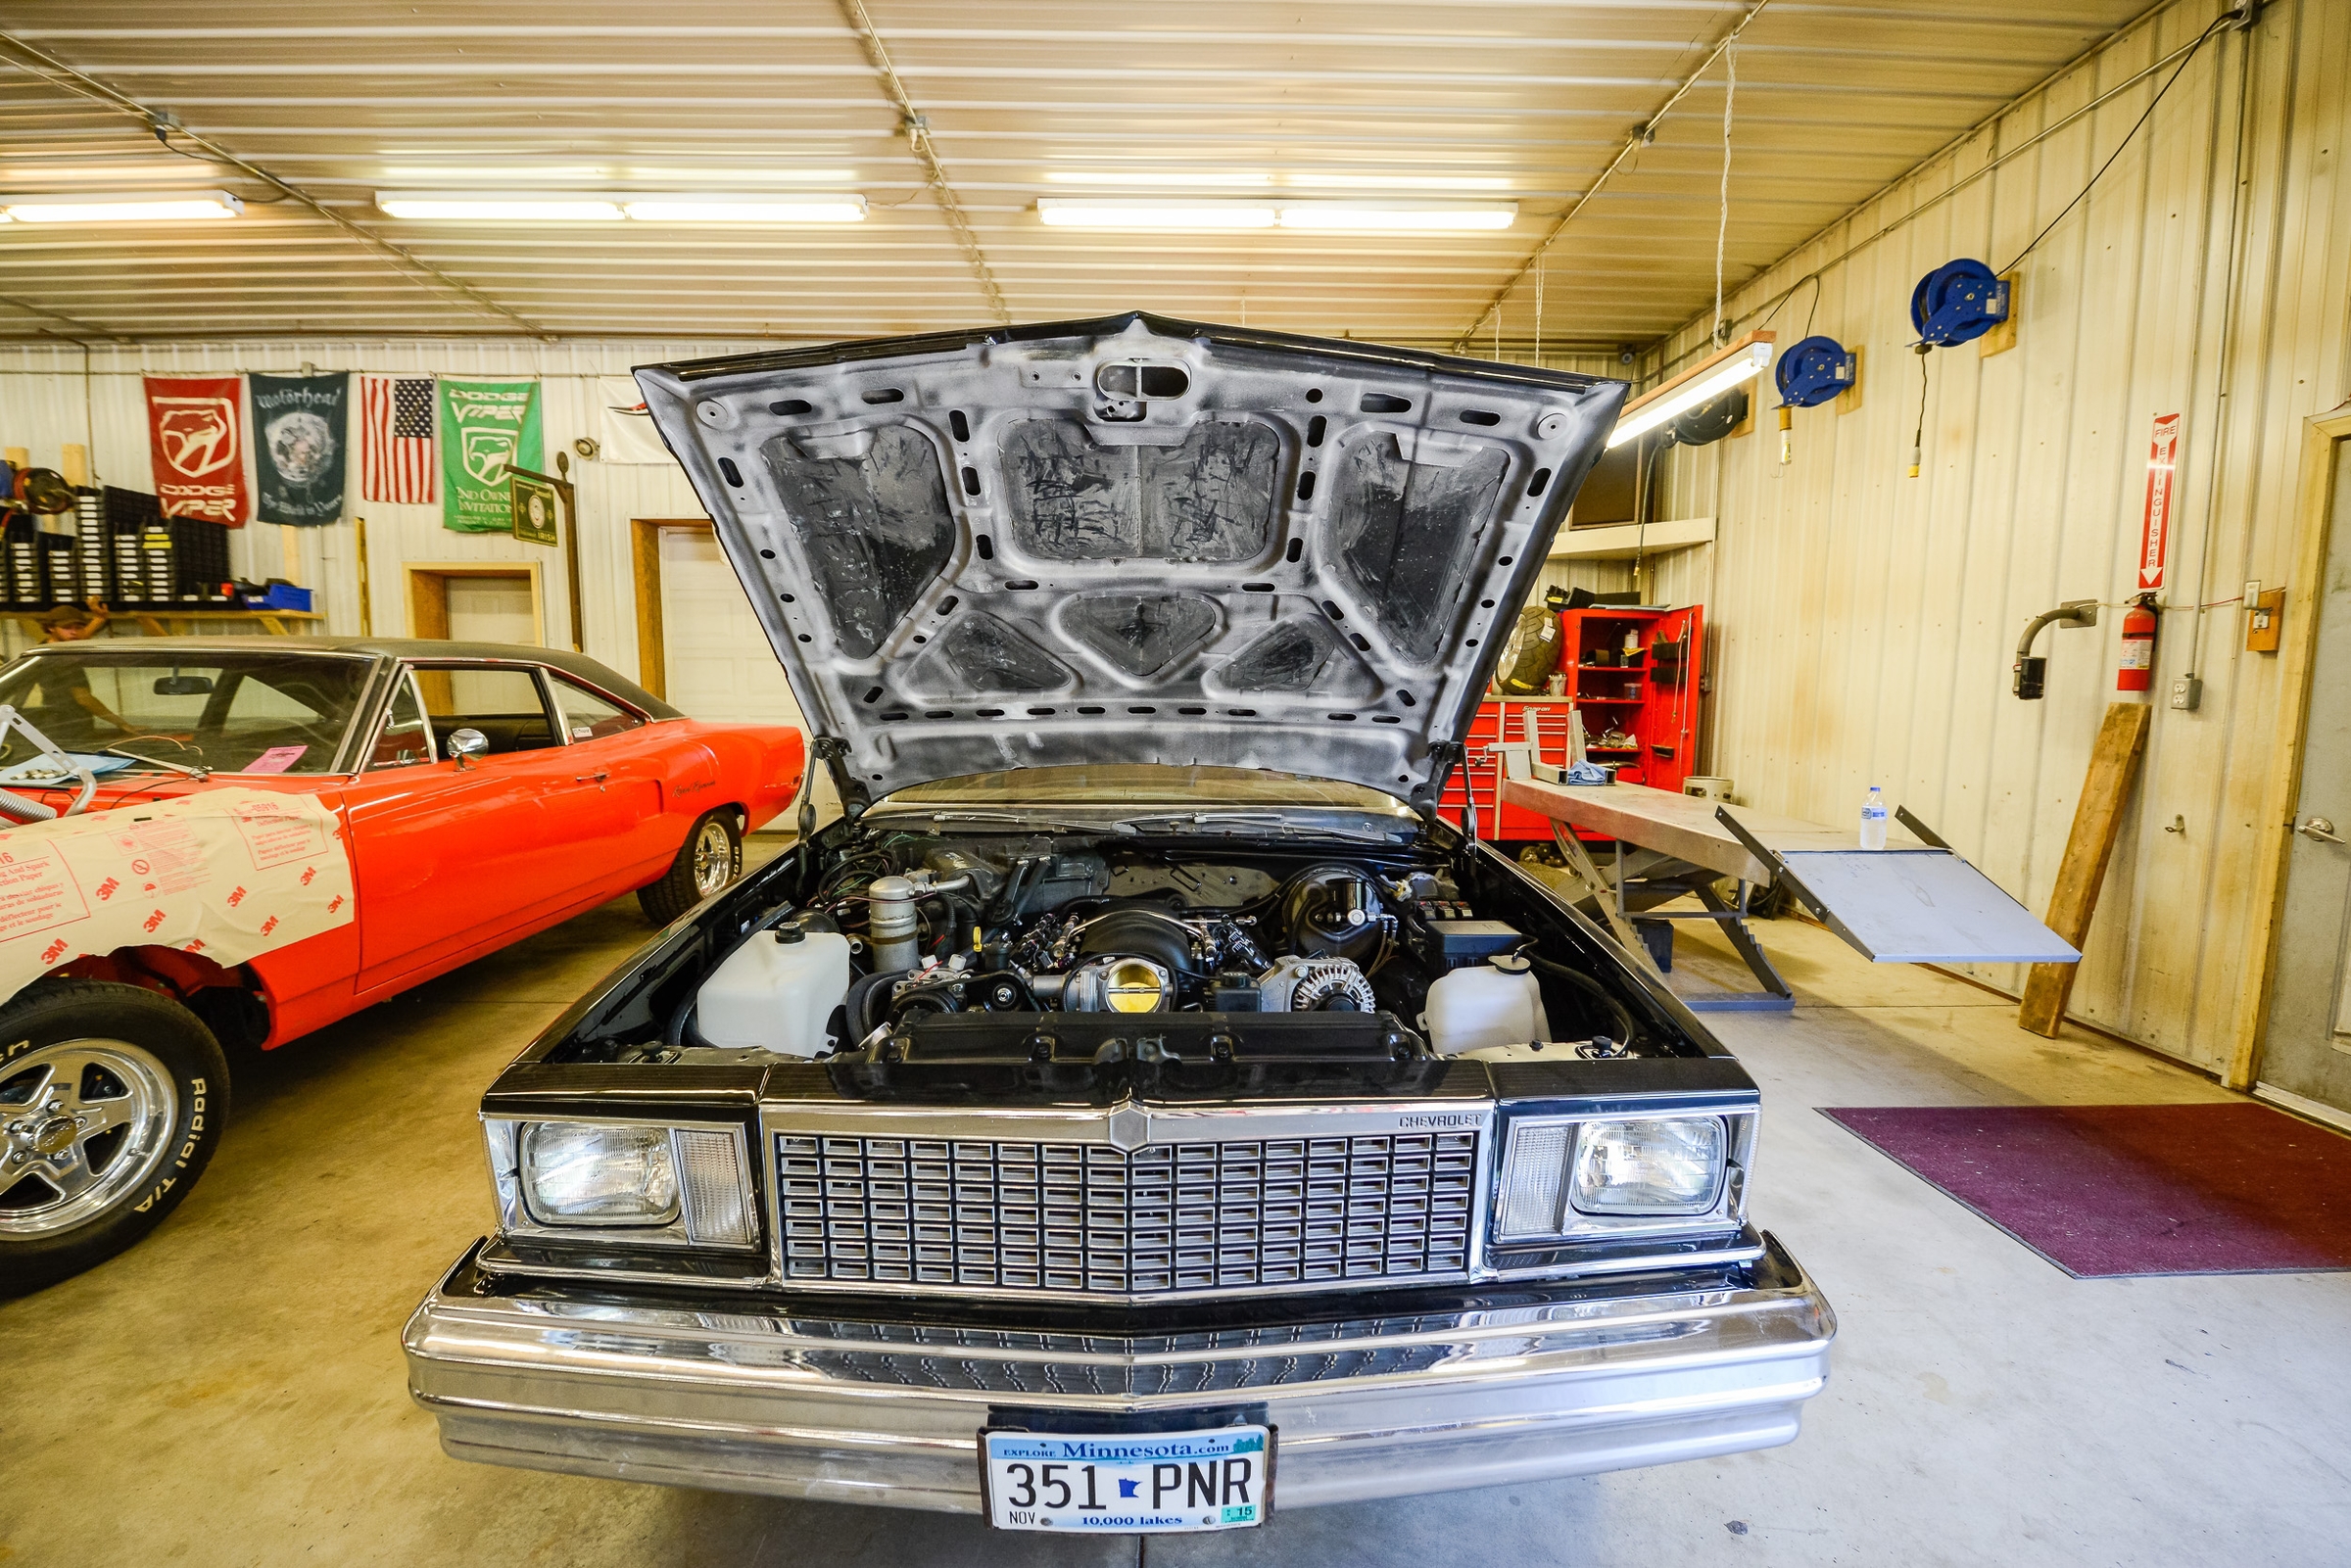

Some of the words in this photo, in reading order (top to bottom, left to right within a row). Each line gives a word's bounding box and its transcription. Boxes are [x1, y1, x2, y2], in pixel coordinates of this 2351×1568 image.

[256, 386, 341, 408] Motörhead
[449, 389, 530, 402] DODGE
[451, 402, 526, 424] VIPER
[2155, 425, 2176, 437] FIRE
[160, 484, 235, 496] DODGE
[161, 498, 236, 521] VIPER
[538, 531, 555, 542] IRISH
[300, 866, 316, 886] 3M
[96, 877, 120, 900] 3M
[227, 885, 247, 907] 3M
[327, 894, 345, 914] 3M
[143, 909, 167, 933] 3M
[260, 915, 279, 936] 3M
[40, 938, 69, 965] 3M
[183, 938, 207, 954] M
[174, 1077, 207, 1168] Radial
[1399, 1115, 1481, 1128] CHEVROLET
[134, 1177, 177, 1212] T/A
[1004, 1449, 1056, 1457] EXPLORE
[1063, 1441, 1229, 1459] Minnesota.com
[1007, 1463, 1107, 1510] 351
[1153, 1457, 1252, 1509] PNR
[1009, 1511, 1035, 1525] NOV
[1237, 1505, 1253, 1516] 15
[1082, 1516, 1134, 1527] 10,000
[1140, 1515, 1183, 1525] lakes
